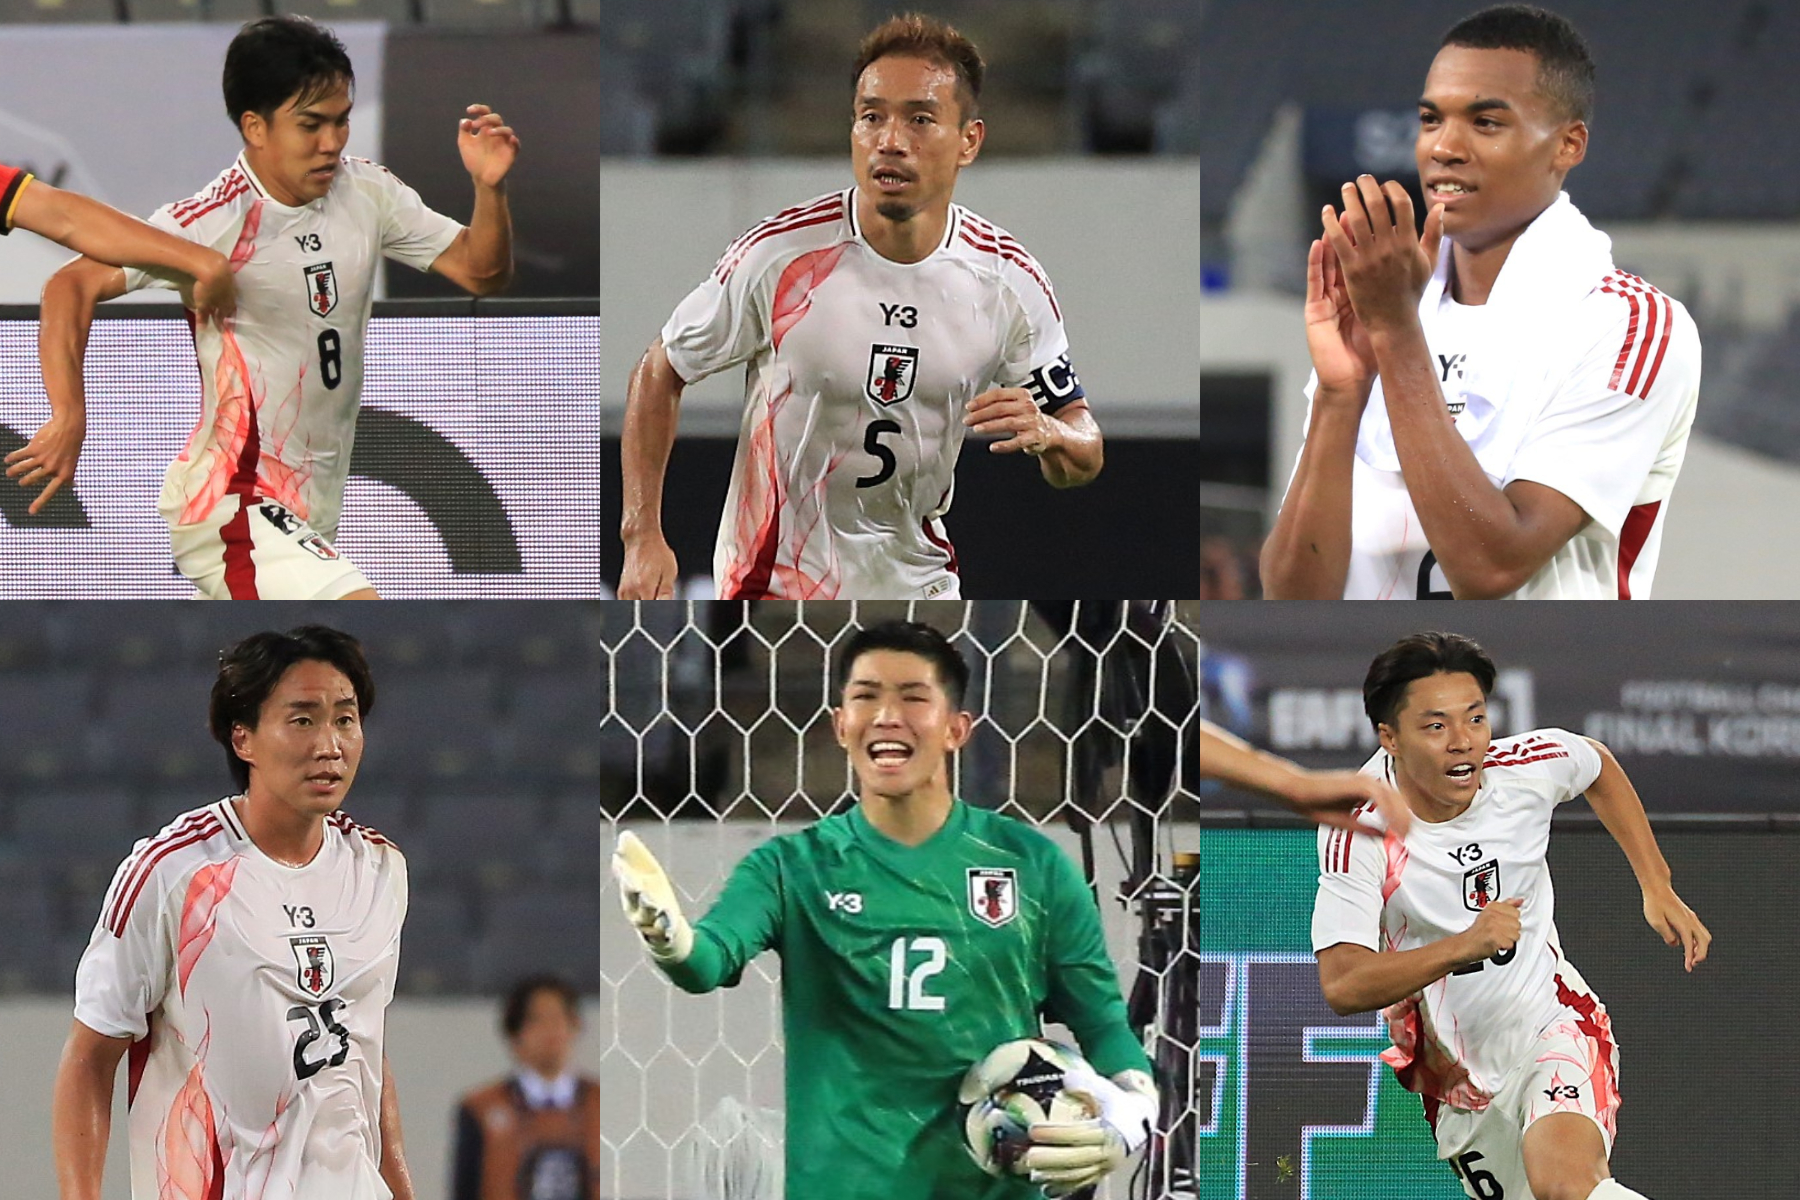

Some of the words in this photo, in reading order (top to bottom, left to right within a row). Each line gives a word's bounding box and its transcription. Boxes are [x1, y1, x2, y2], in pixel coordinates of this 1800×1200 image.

[310, 263, 327, 272] JAPAN
[317, 328, 341, 391] 8
[882, 346, 908, 355] JAPAN
[855, 419, 901, 488] 5
[1471, 862, 1491, 874] JAPAN
[298, 937, 319, 945] JAPAN
[889, 936, 946, 1010] 12
[286, 998, 350, 1081] 25
